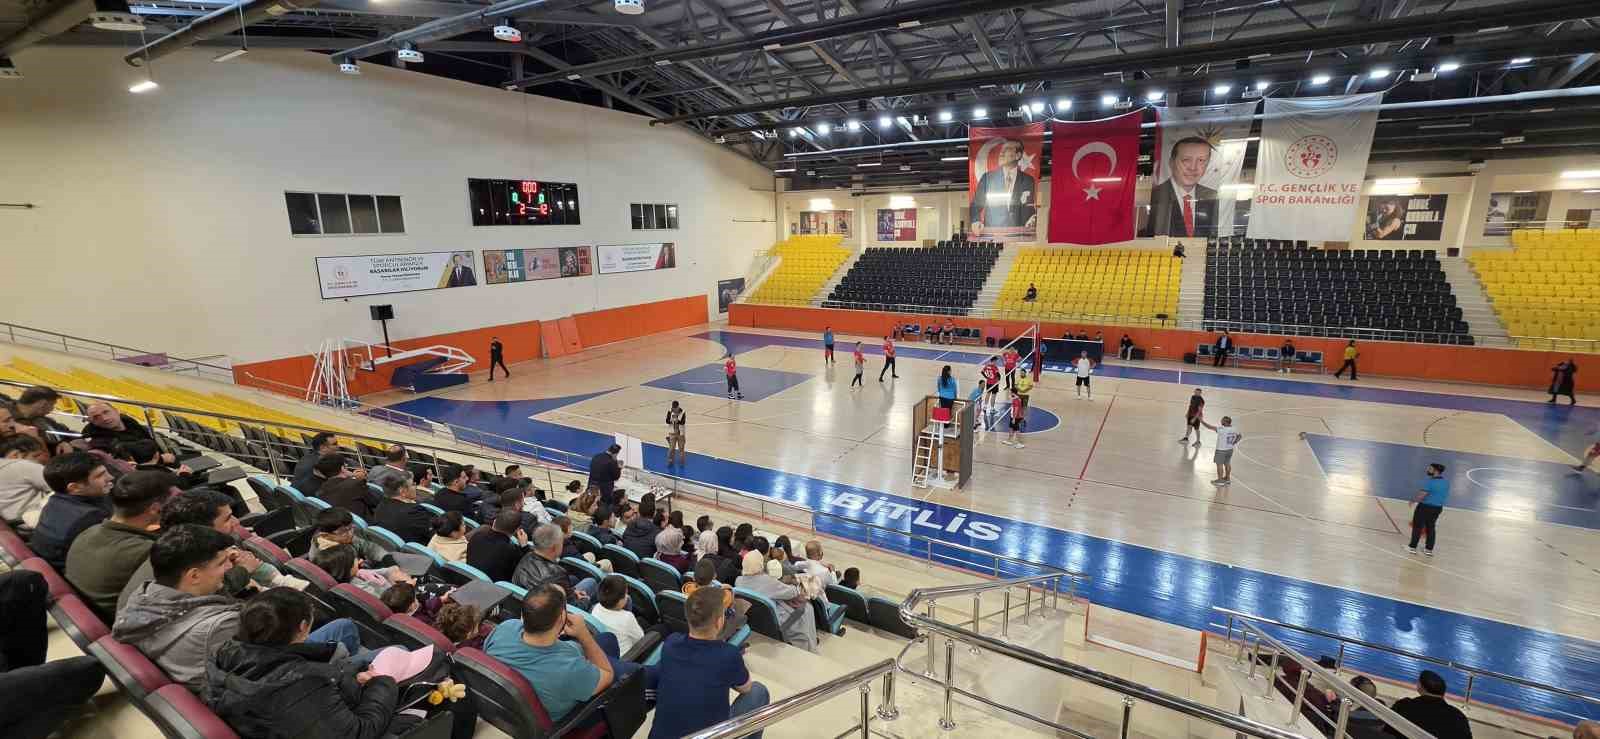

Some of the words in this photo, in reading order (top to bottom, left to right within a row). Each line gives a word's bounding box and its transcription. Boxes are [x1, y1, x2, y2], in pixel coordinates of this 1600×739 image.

[522, 181, 537, 193] 000
[1341, 183, 1358, 193] VE
[1256, 195, 1285, 205] SPOR
